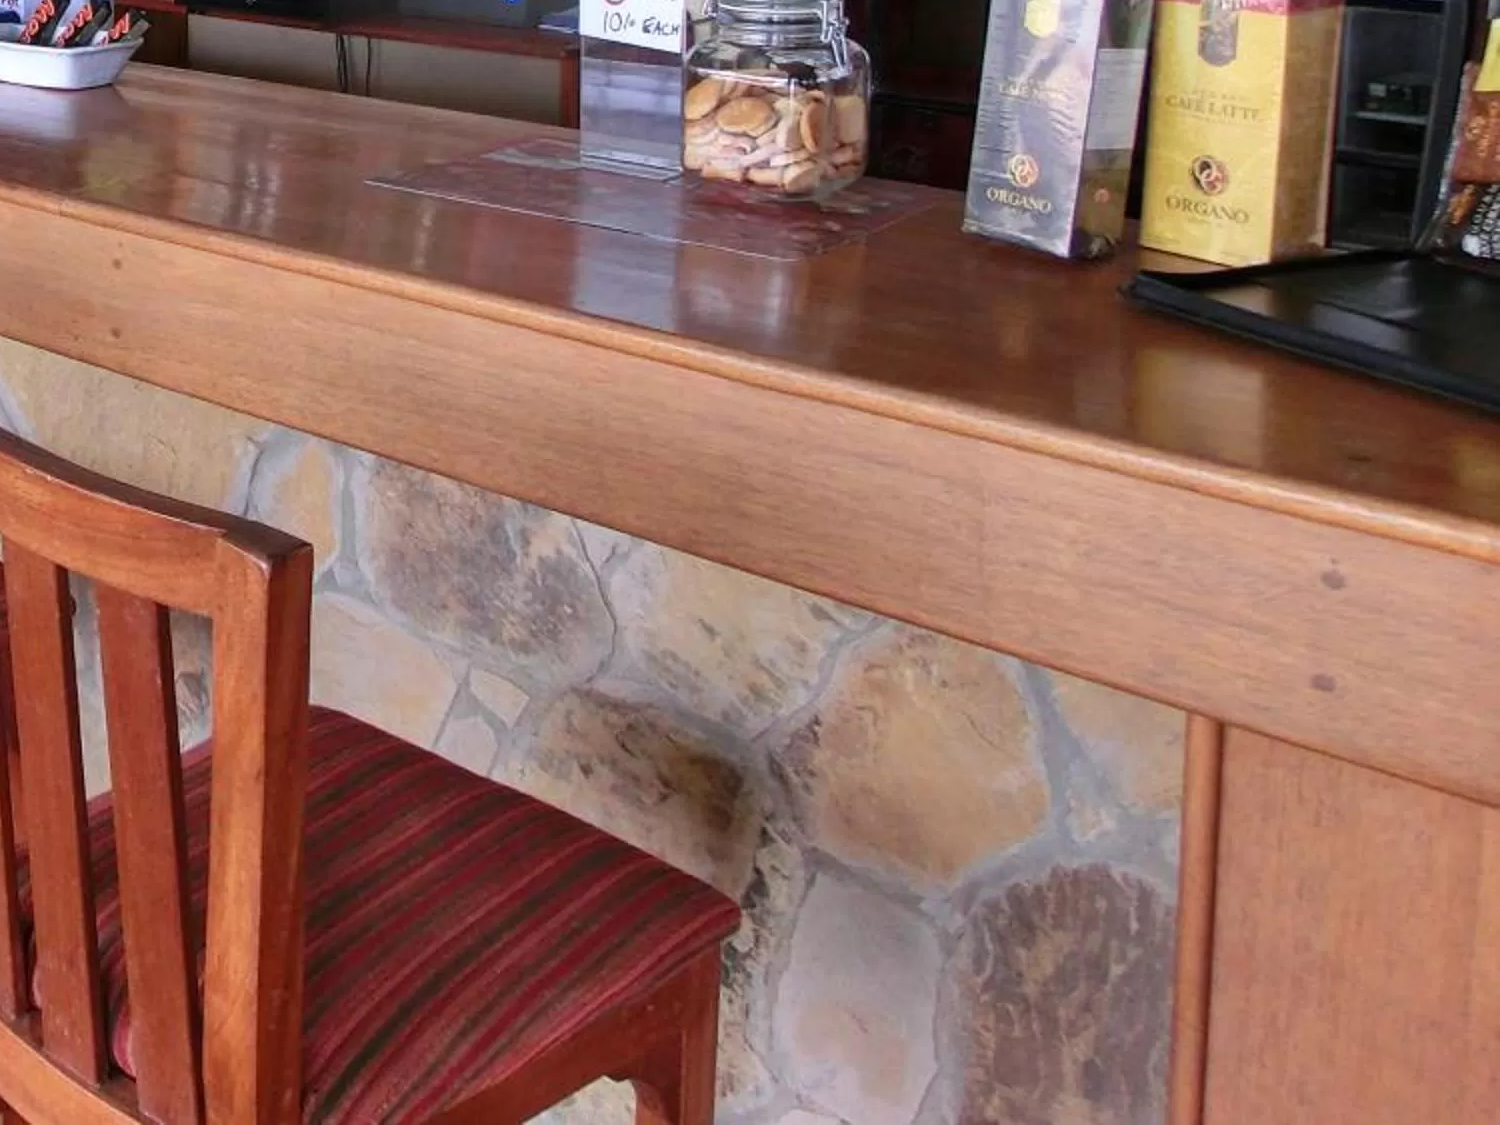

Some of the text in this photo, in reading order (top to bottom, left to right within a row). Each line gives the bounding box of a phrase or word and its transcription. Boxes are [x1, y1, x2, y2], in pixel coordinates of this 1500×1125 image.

[642, 16, 681, 36] EACH
[985, 186, 1051, 213] ORGANO
[1165, 194, 1250, 224] ORGANO
